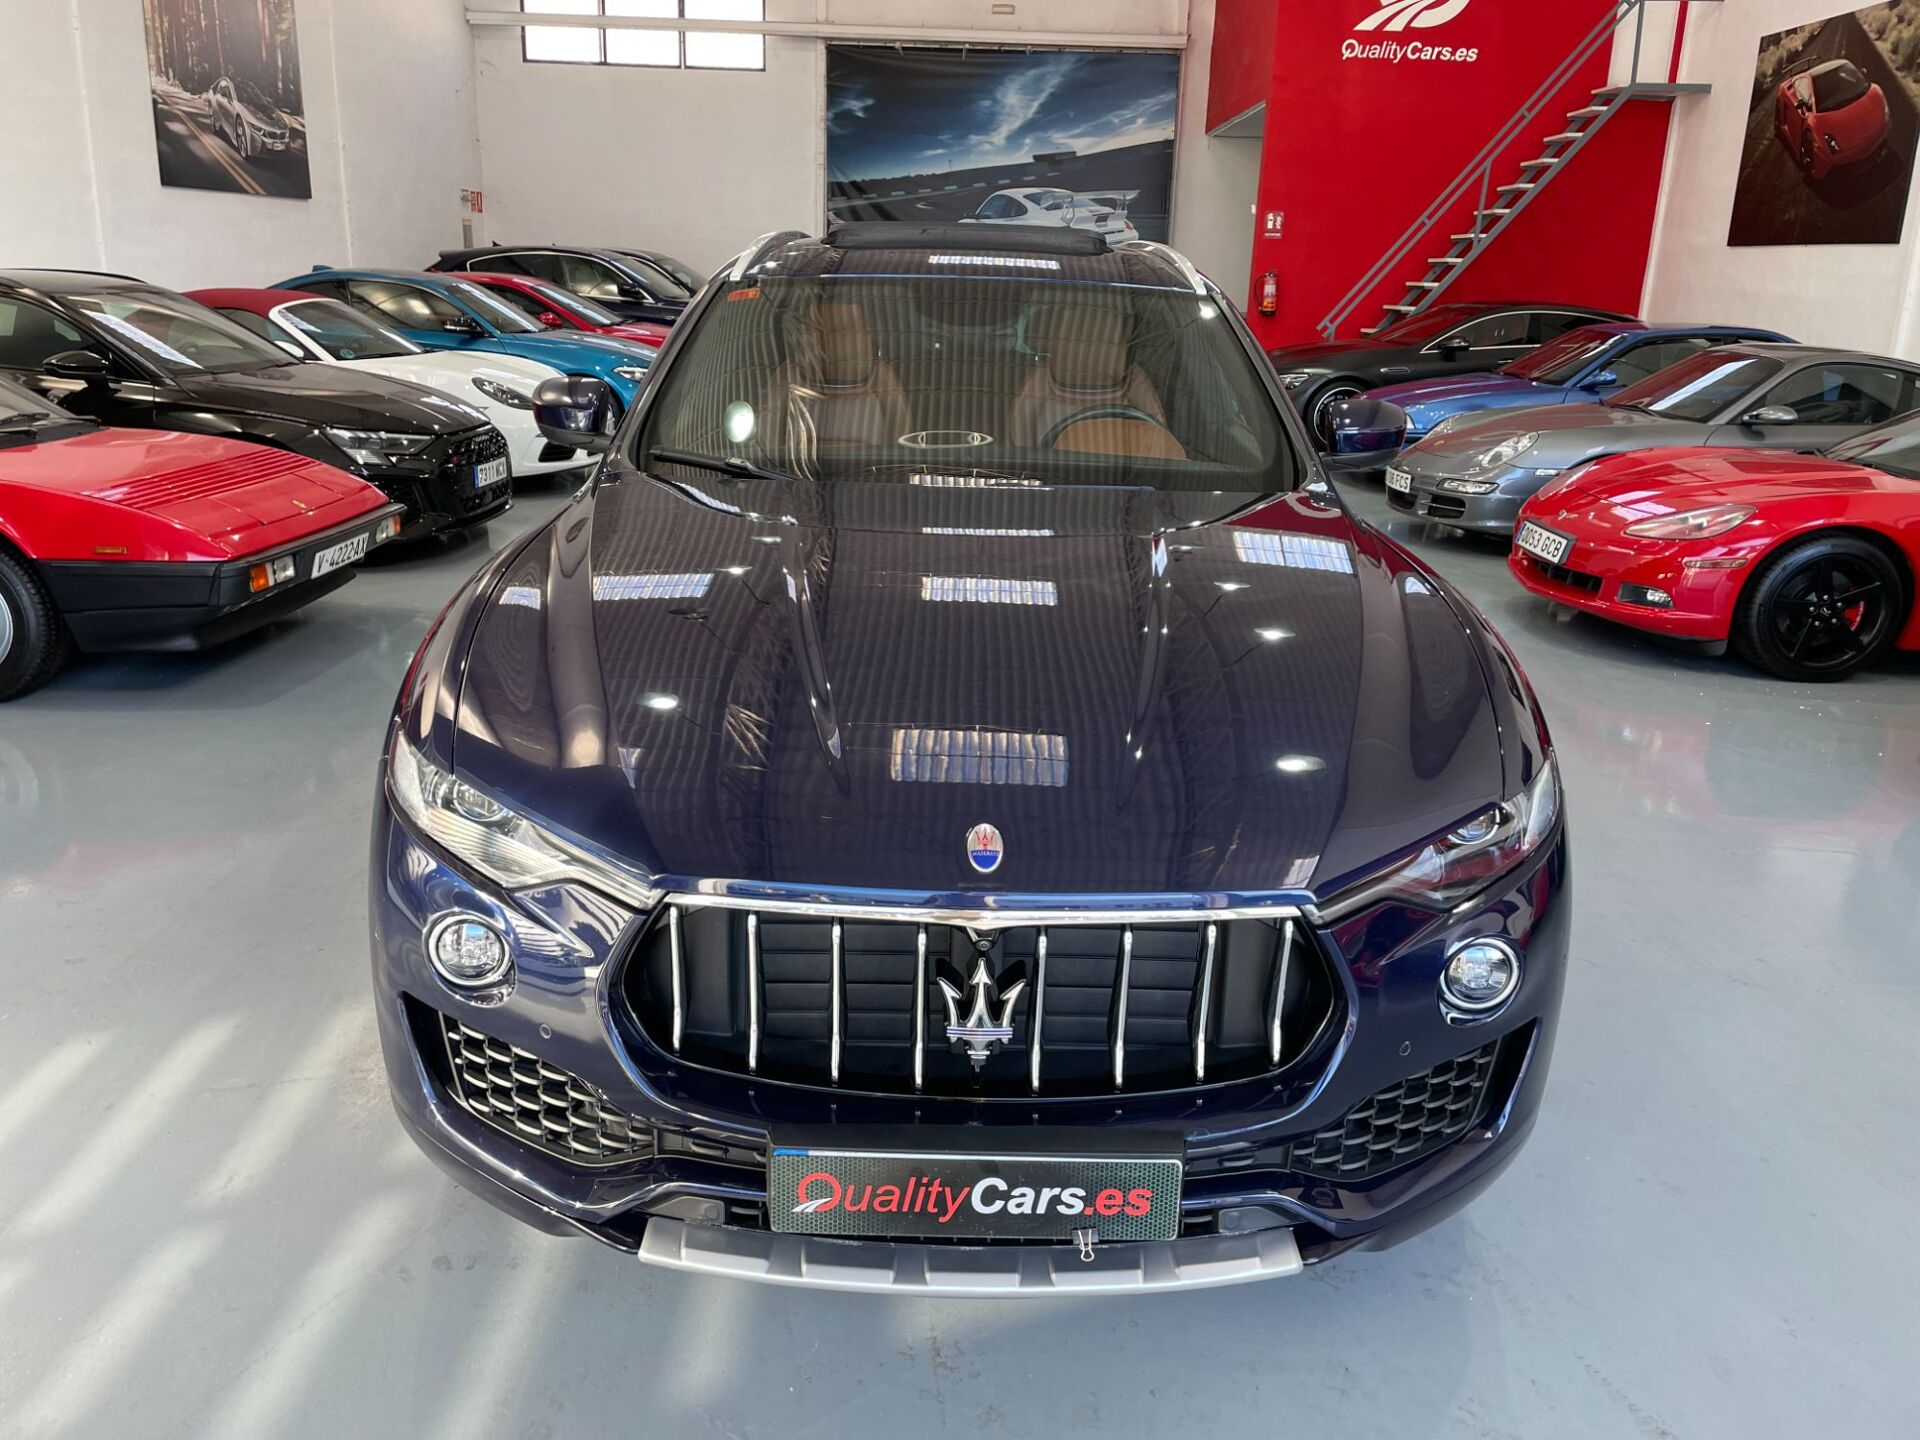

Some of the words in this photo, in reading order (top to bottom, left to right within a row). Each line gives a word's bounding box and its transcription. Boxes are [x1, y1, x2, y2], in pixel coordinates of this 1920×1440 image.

[1341, 38, 1479, 64] QualityCars.es
[1541, 536, 1563, 558] GCB
[791, 1171, 1154, 1224] QualityCars.es
